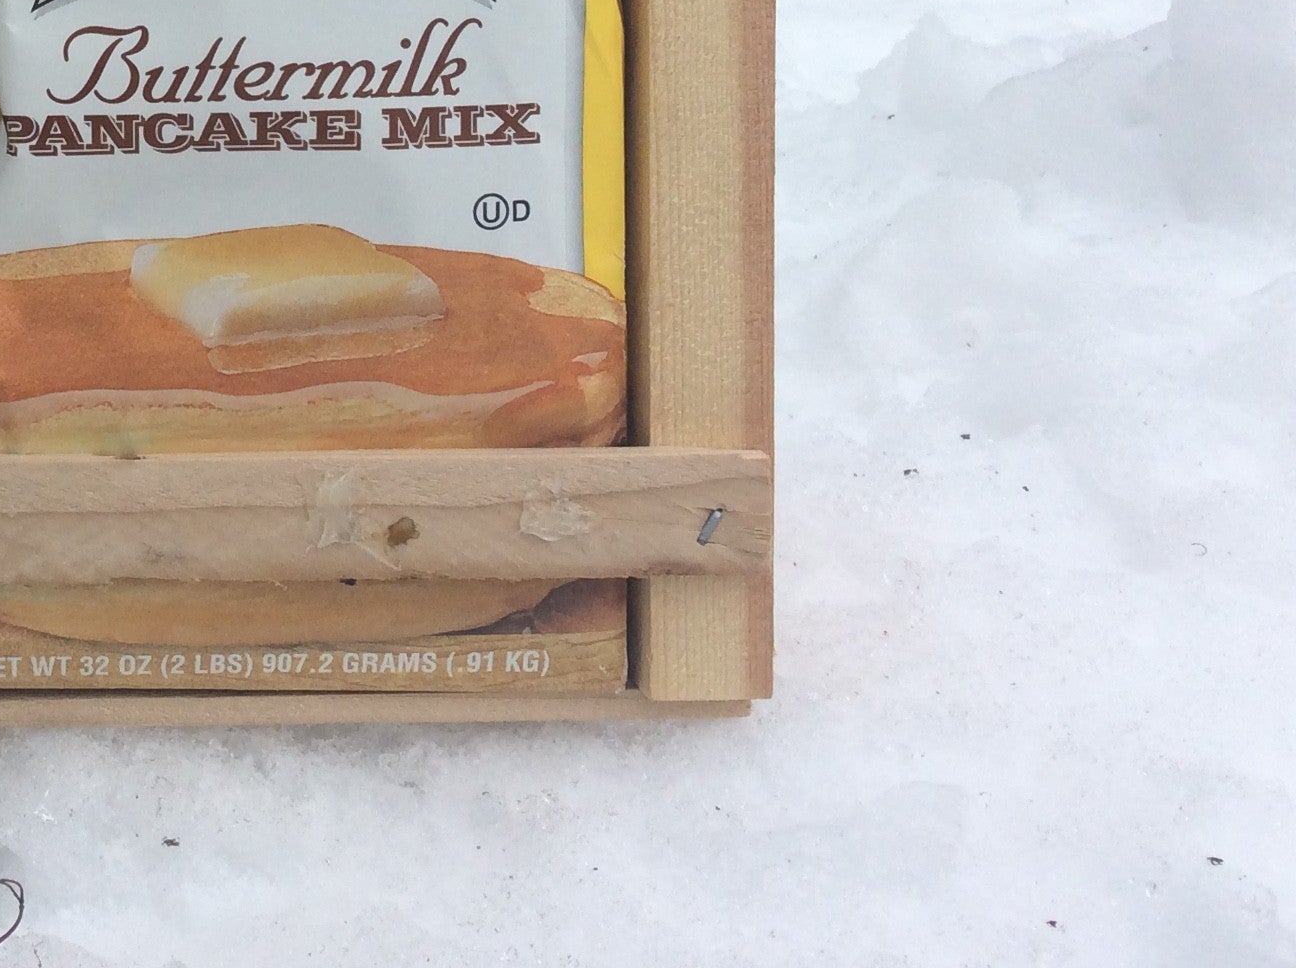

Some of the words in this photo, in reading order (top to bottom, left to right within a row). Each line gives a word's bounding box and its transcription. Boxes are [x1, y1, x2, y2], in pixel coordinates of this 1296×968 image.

[46, 17, 483, 106] Buttermilk
[3, 109, 361, 156] PANCAKE
[382, 103, 541, 149] MIX
[30, 656, 72, 677] WT
[79, 656, 110, 677] 32
[118, 655, 153, 676] OZ
[160, 655, 186, 679] (2
[194, 653, 254, 678] LBS)
[262, 653, 333, 675] 907.2
[341, 651, 438, 674] GRAMS
[445, 651, 495, 677] (.91
[504, 650, 551, 676] KG)
